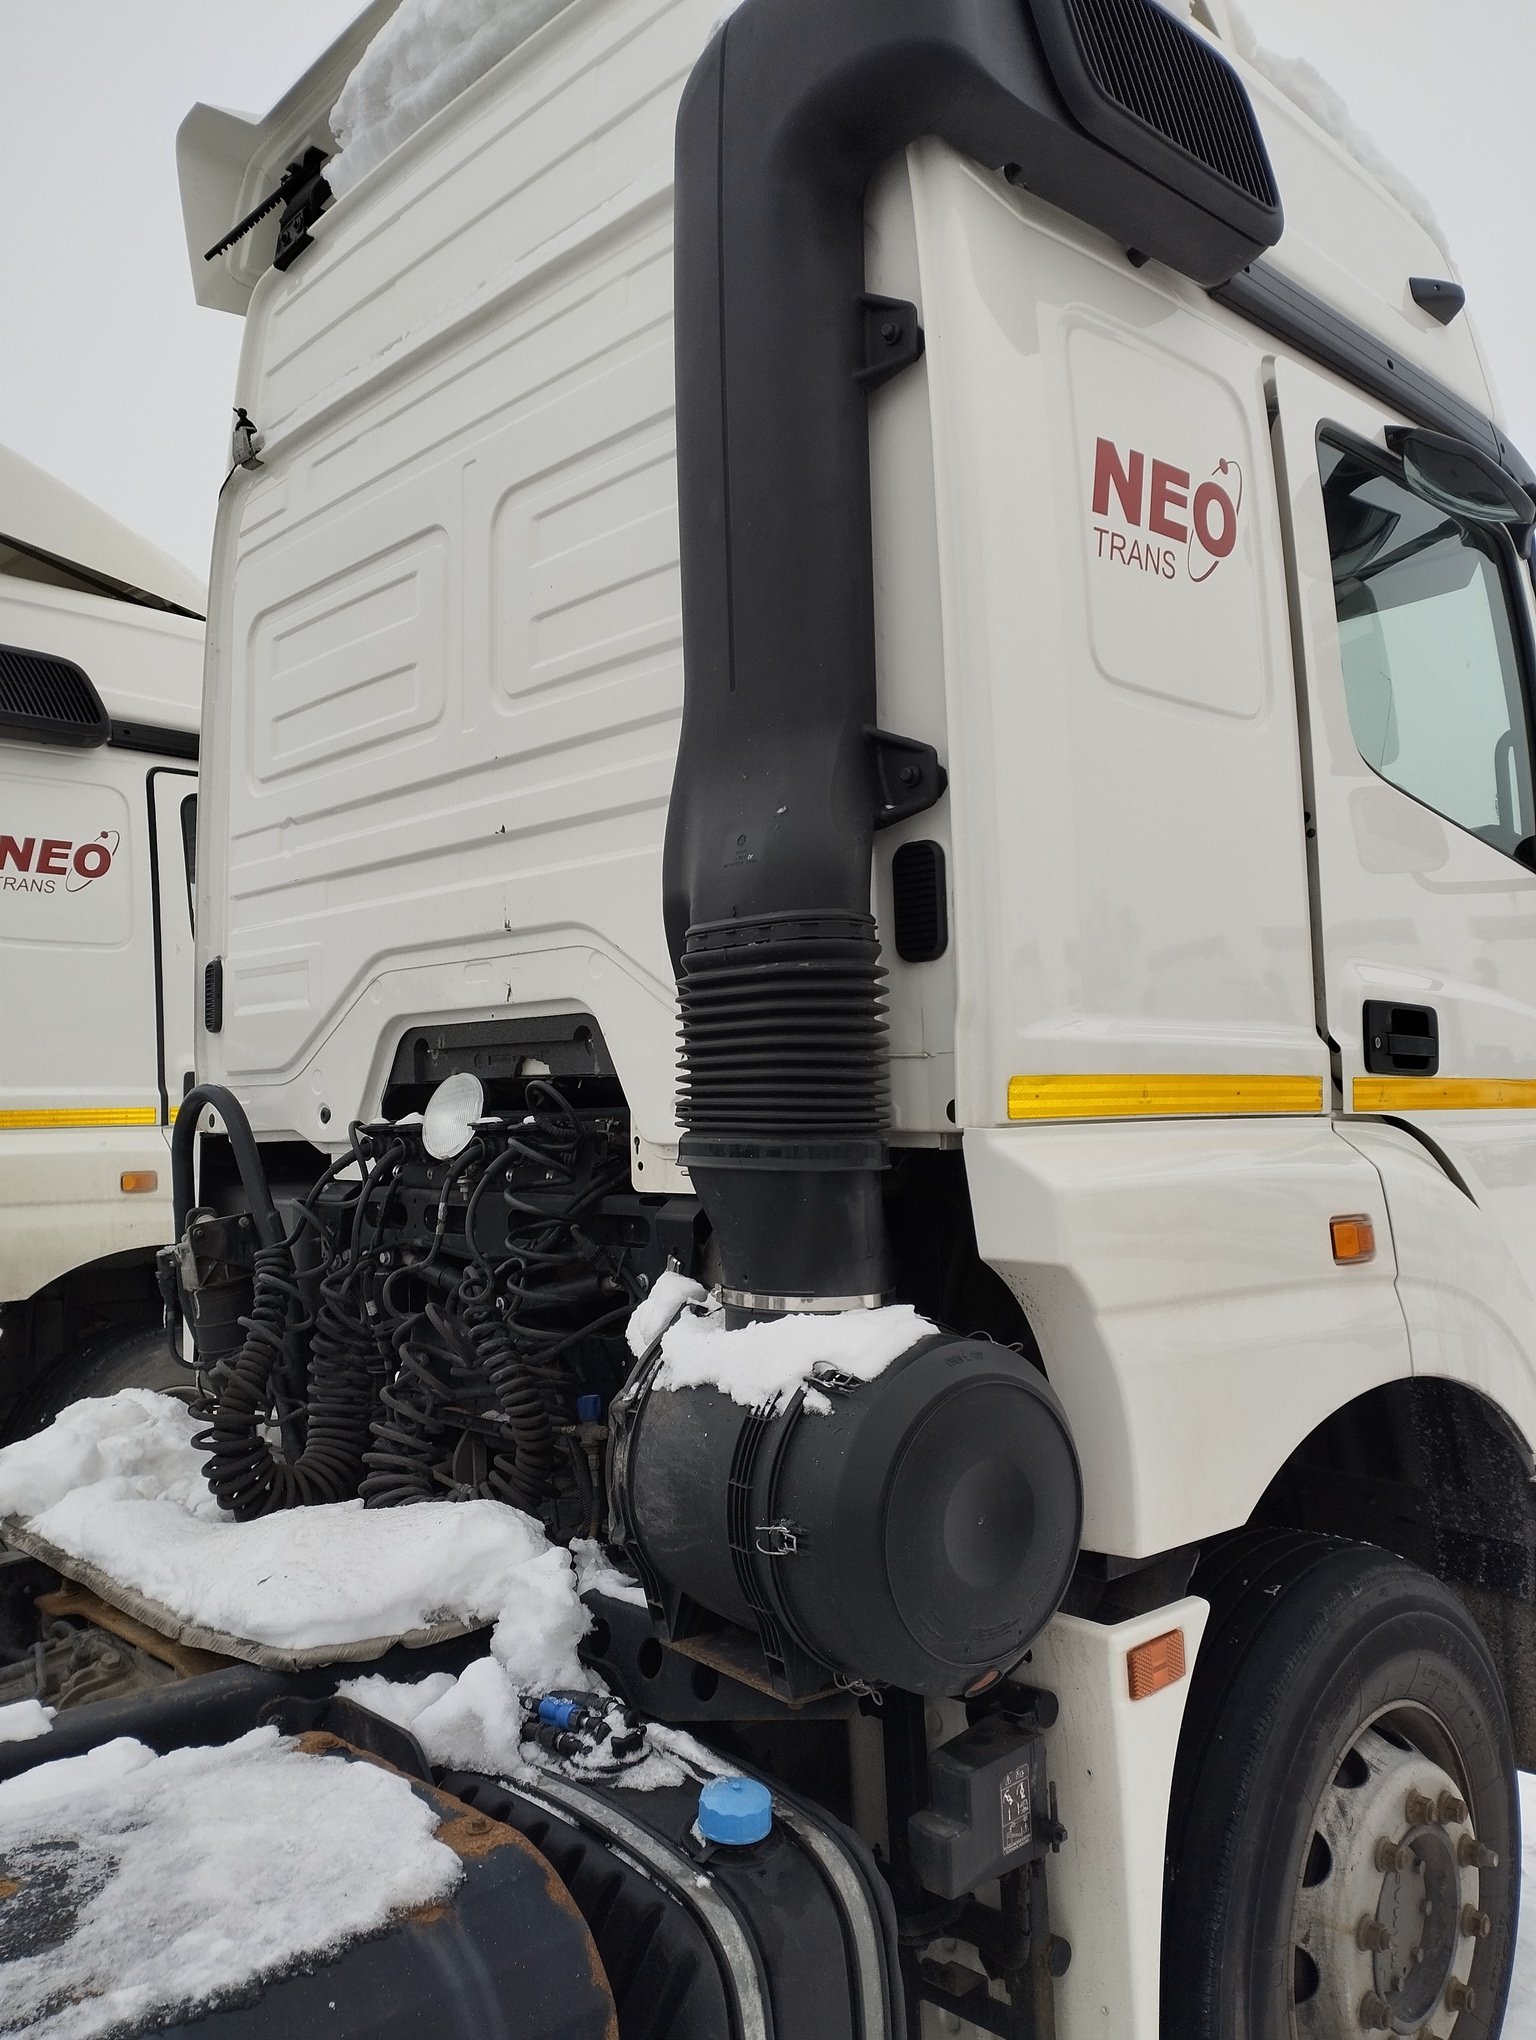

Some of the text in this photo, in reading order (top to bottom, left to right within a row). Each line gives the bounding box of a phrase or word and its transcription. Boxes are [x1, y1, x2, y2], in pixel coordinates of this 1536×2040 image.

[1092, 436, 1238, 558] NEO
[1093, 526, 1176, 580] TRANS
[0, 834, 112, 878] NEO
[0, 876, 56, 894] RANS
